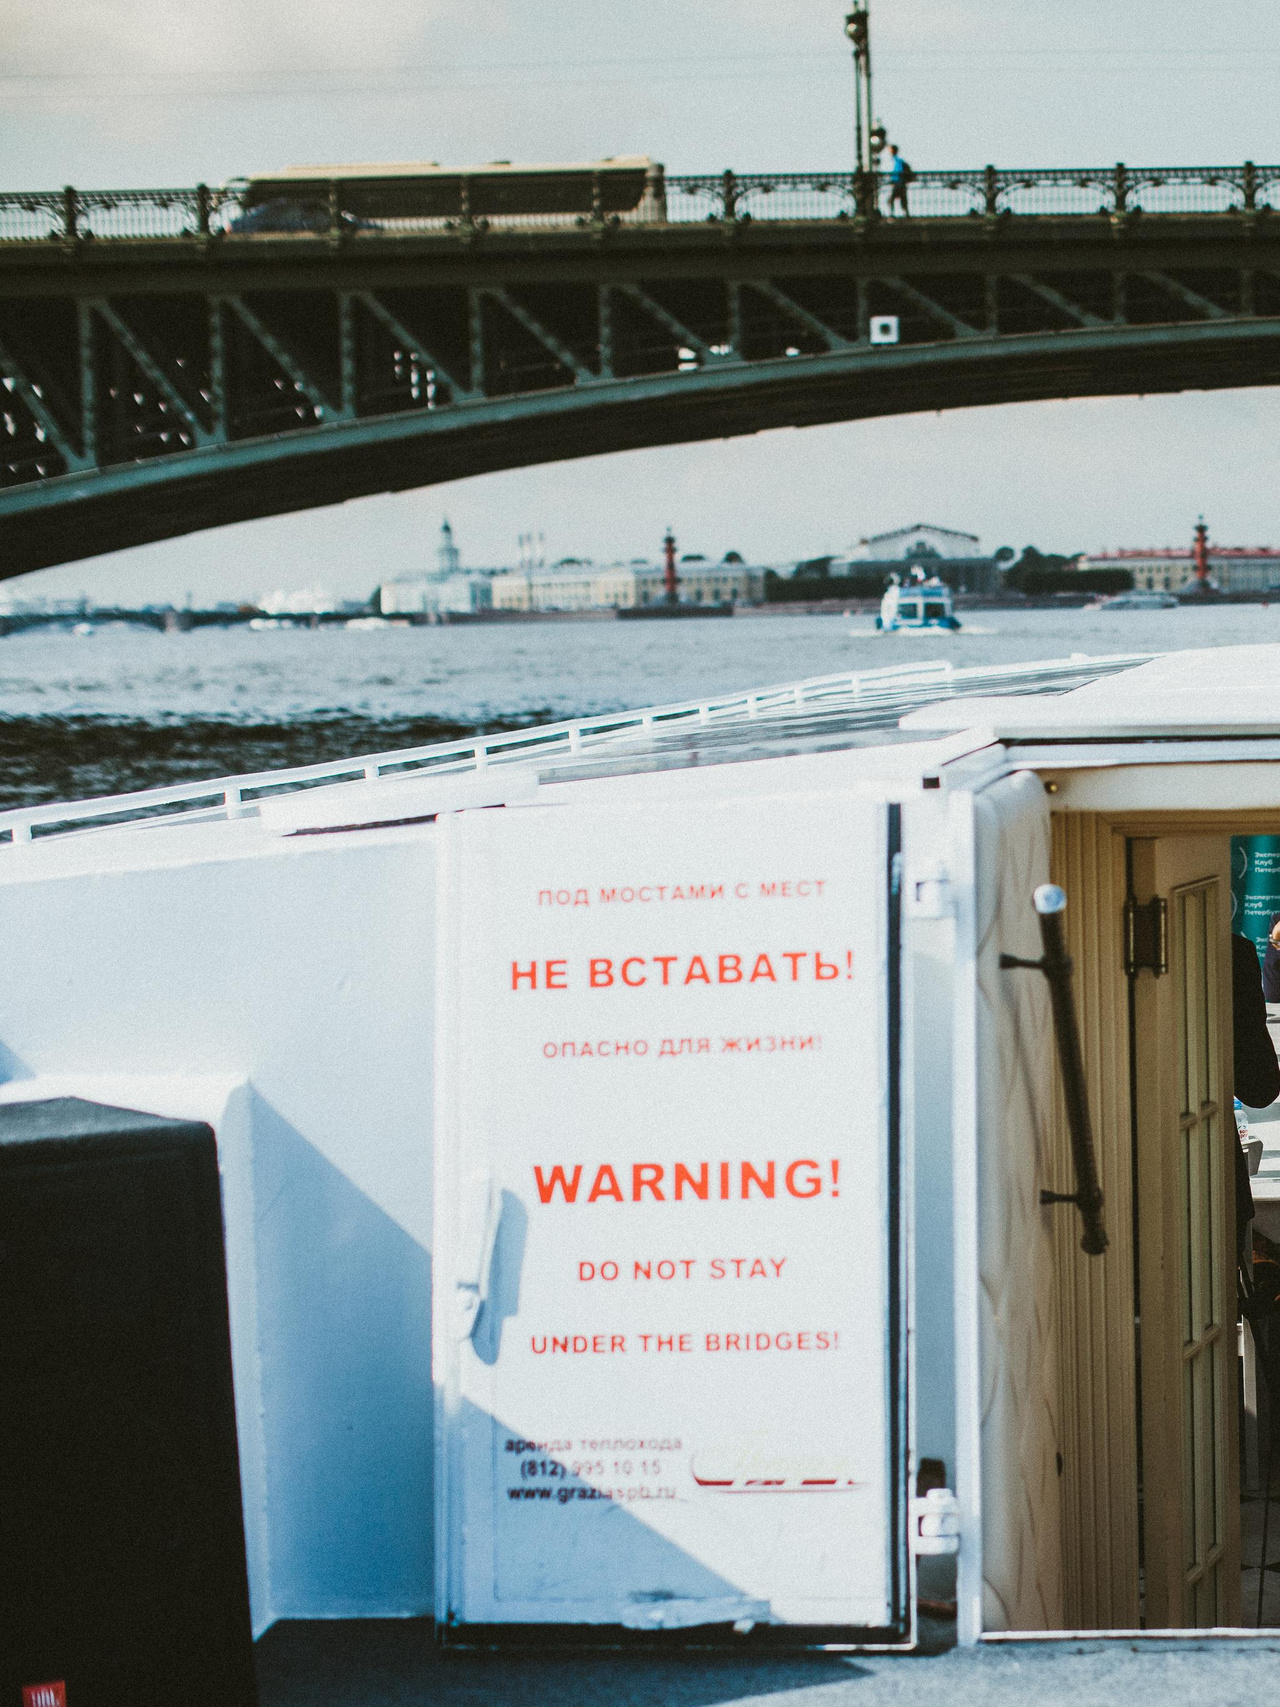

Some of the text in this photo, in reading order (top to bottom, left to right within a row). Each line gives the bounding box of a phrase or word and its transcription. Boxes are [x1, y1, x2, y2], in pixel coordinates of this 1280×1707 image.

[537, 879, 828, 908] ПОД МОСТАМИ С МЕСТ
[511, 950, 855, 992] НЕ ВСТАВАТЬ!
[543, 1034, 823, 1060] ОПАСНО ДЛЯ ЖИЗНИ!
[533, 1159, 842, 1205] WARNING!
[578, 1257, 788, 1283] DO NOT STAY
[531, 1330, 841, 1356] UNDER THE BRIDGES!
[505, 1438, 573, 1454] аренда
[520, 1459, 567, 1480] (812)
[572, 1458, 604, 1477] 995
